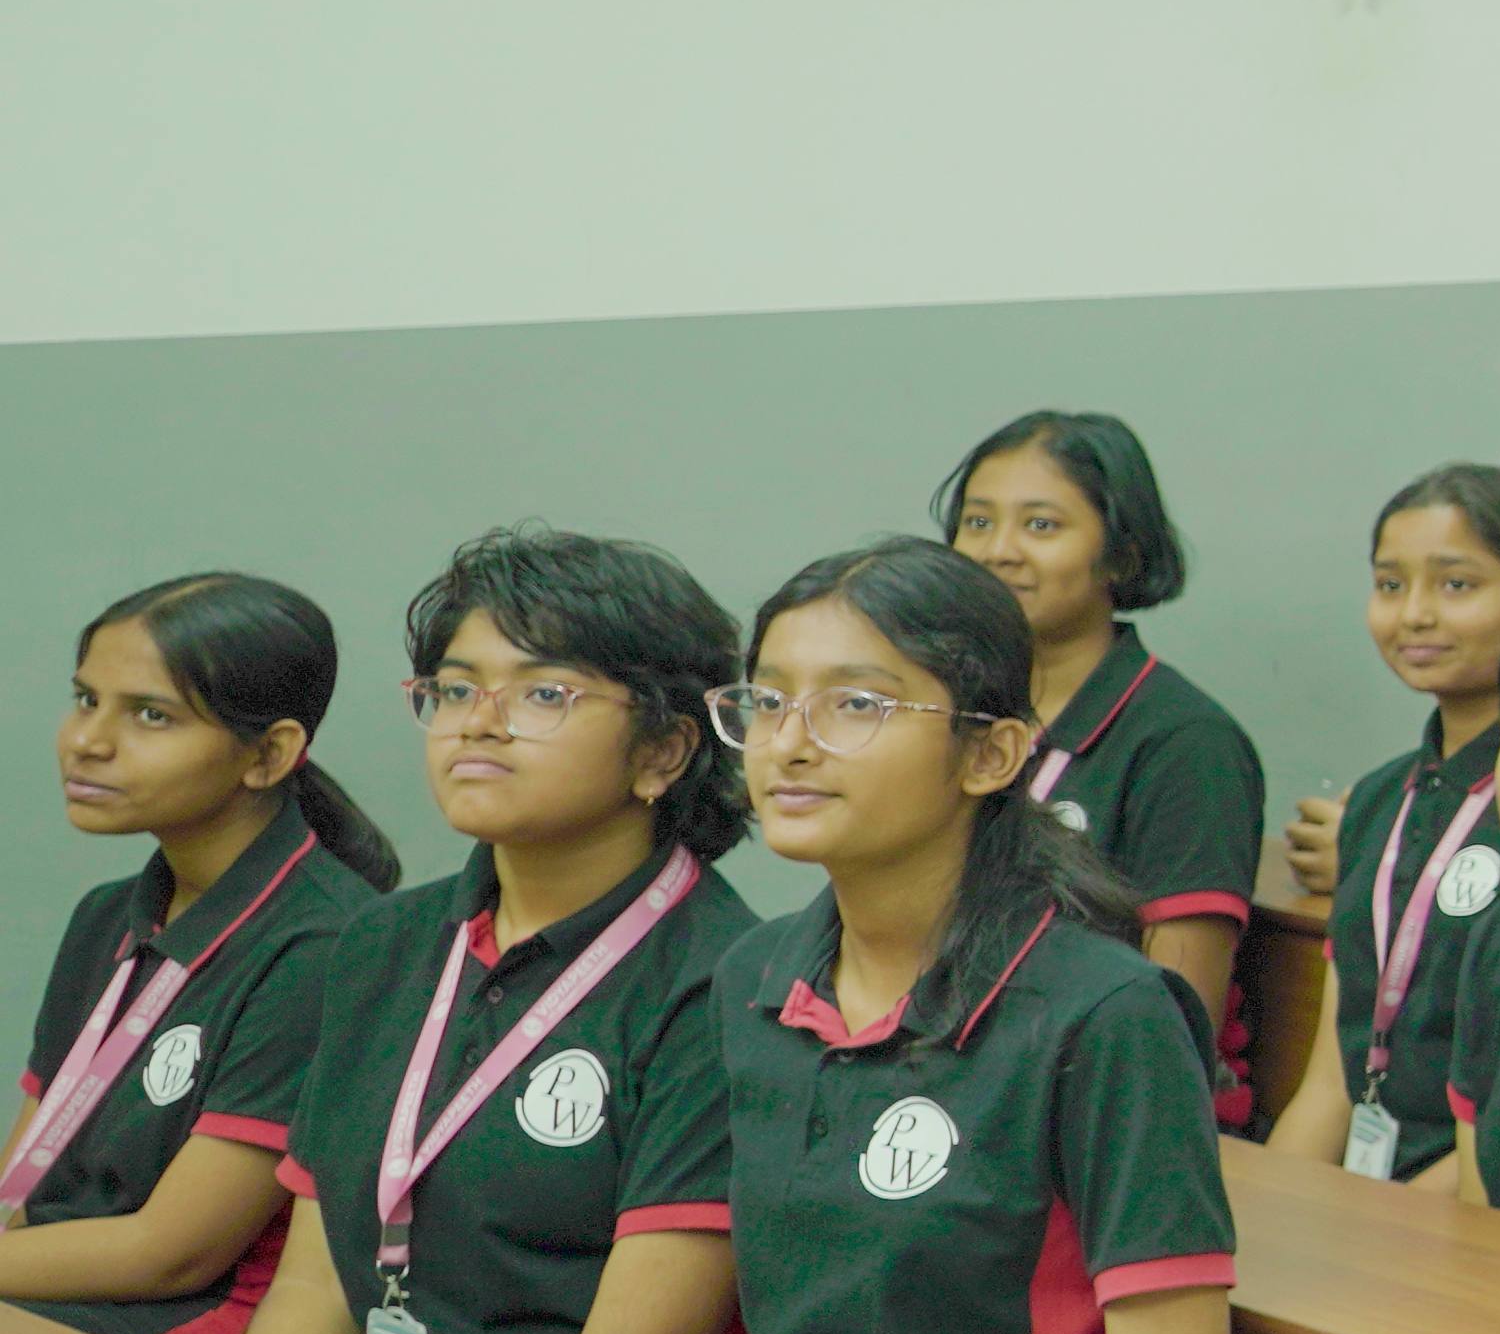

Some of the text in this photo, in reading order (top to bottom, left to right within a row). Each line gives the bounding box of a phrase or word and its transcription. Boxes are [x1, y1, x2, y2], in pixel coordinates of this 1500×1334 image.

[1455, 858, 1487, 908] PW
[535, 940, 609, 1015] VIDYAPEETH
[162, 1038, 195, 1093] PW
[547, 1066, 592, 1139] PW
[882, 1113, 934, 1190] PW
